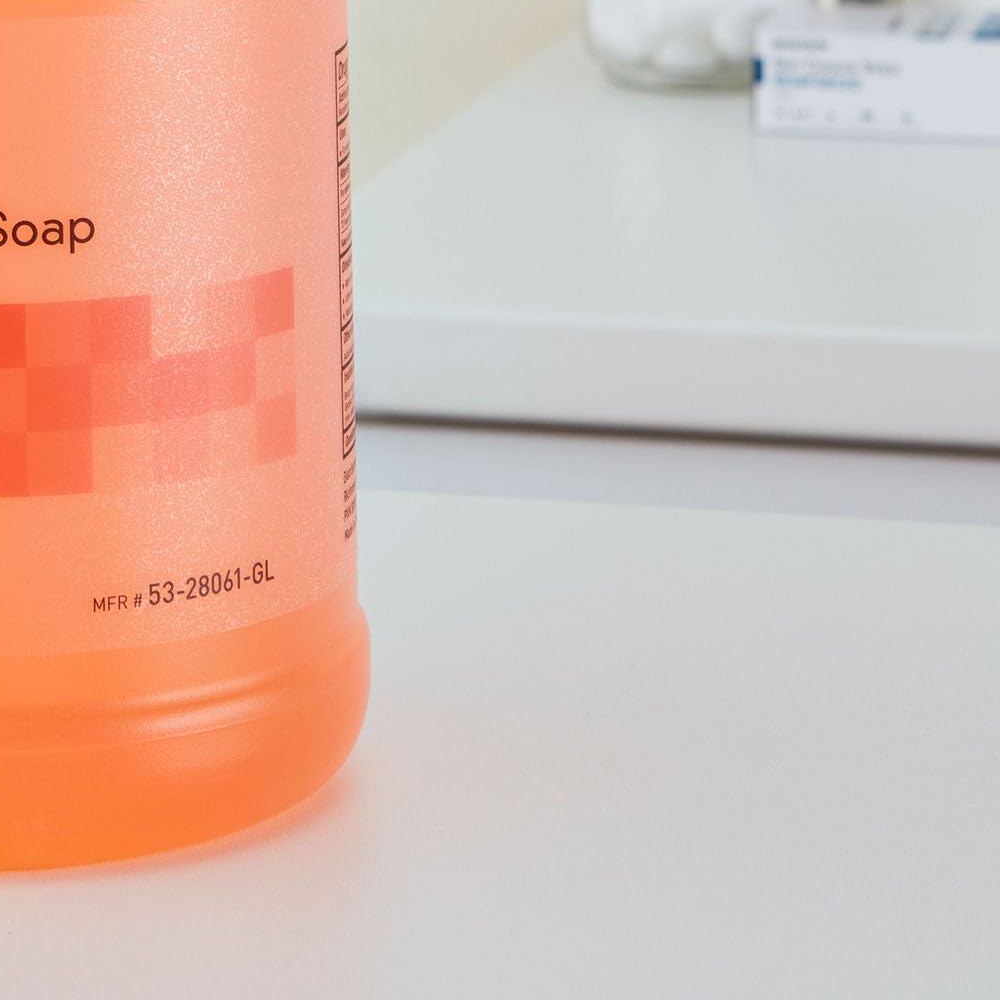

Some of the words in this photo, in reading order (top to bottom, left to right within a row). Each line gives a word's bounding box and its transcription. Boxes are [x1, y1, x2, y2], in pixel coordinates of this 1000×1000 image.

[93, 594, 129, 613] MFR
[133, 593, 143, 608] #
[148, 559, 275, 606] 53-28061-GL
